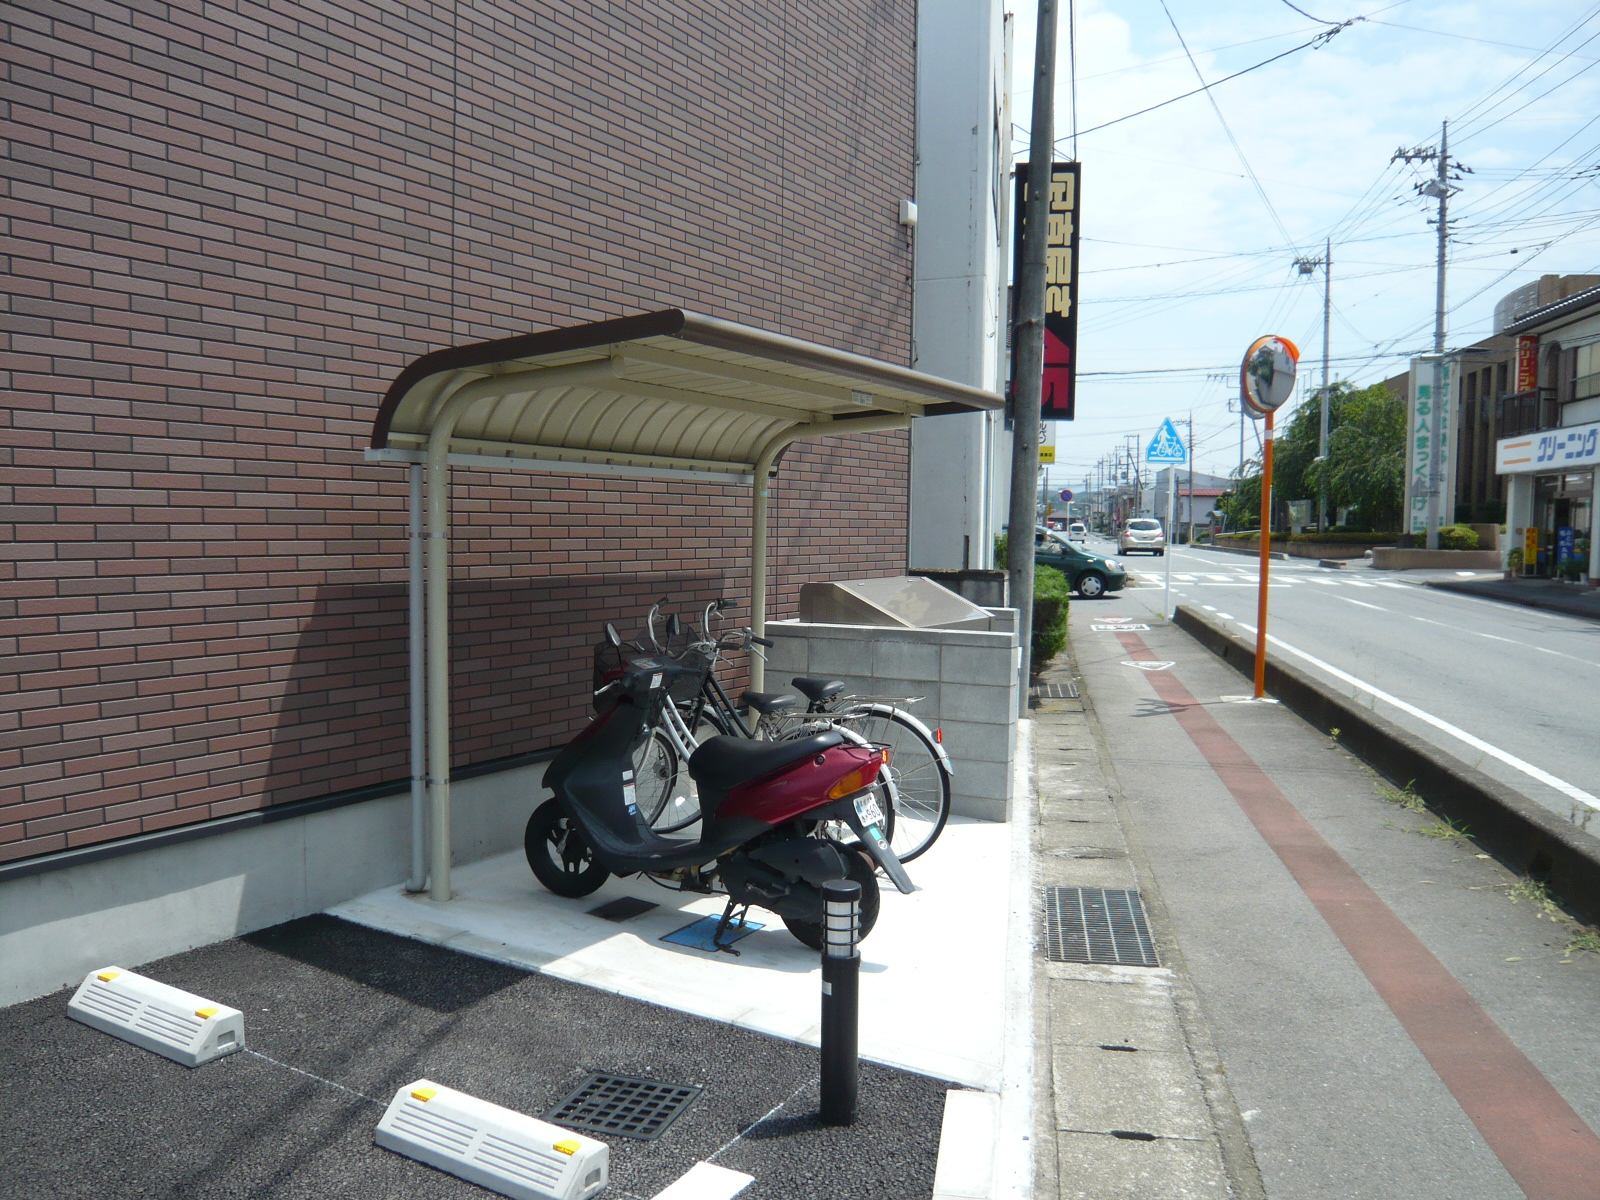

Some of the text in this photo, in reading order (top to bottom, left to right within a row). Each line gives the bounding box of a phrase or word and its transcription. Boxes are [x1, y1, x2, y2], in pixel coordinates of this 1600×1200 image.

[1519, 340, 1531, 392] クリーニング
[1537, 428, 1599, 463] クリーニング
